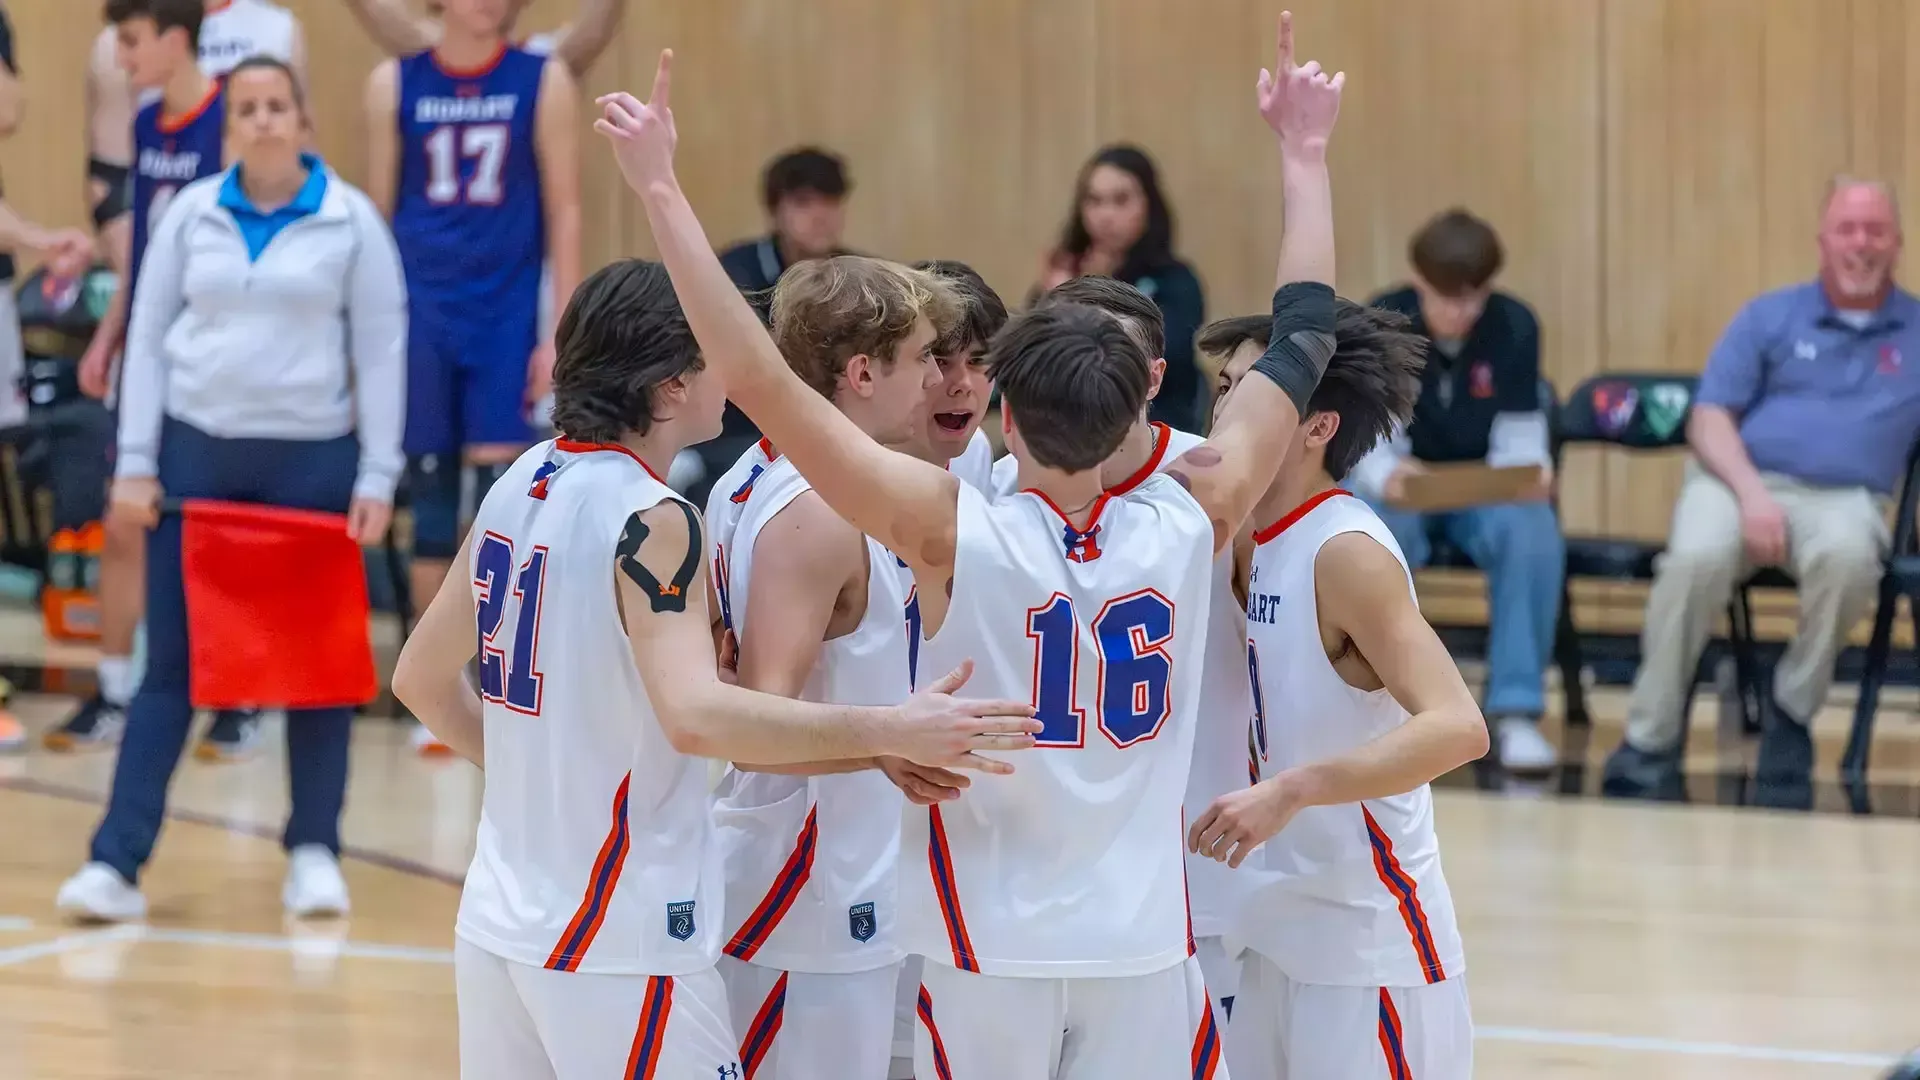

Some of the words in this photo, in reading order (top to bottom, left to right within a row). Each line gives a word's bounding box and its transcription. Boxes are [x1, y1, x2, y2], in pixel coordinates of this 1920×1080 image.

[423, 123, 512, 206] 17
[474, 530, 549, 716] 21
[1026, 587, 1175, 749] 16
[850, 904, 873, 915] UNITED
